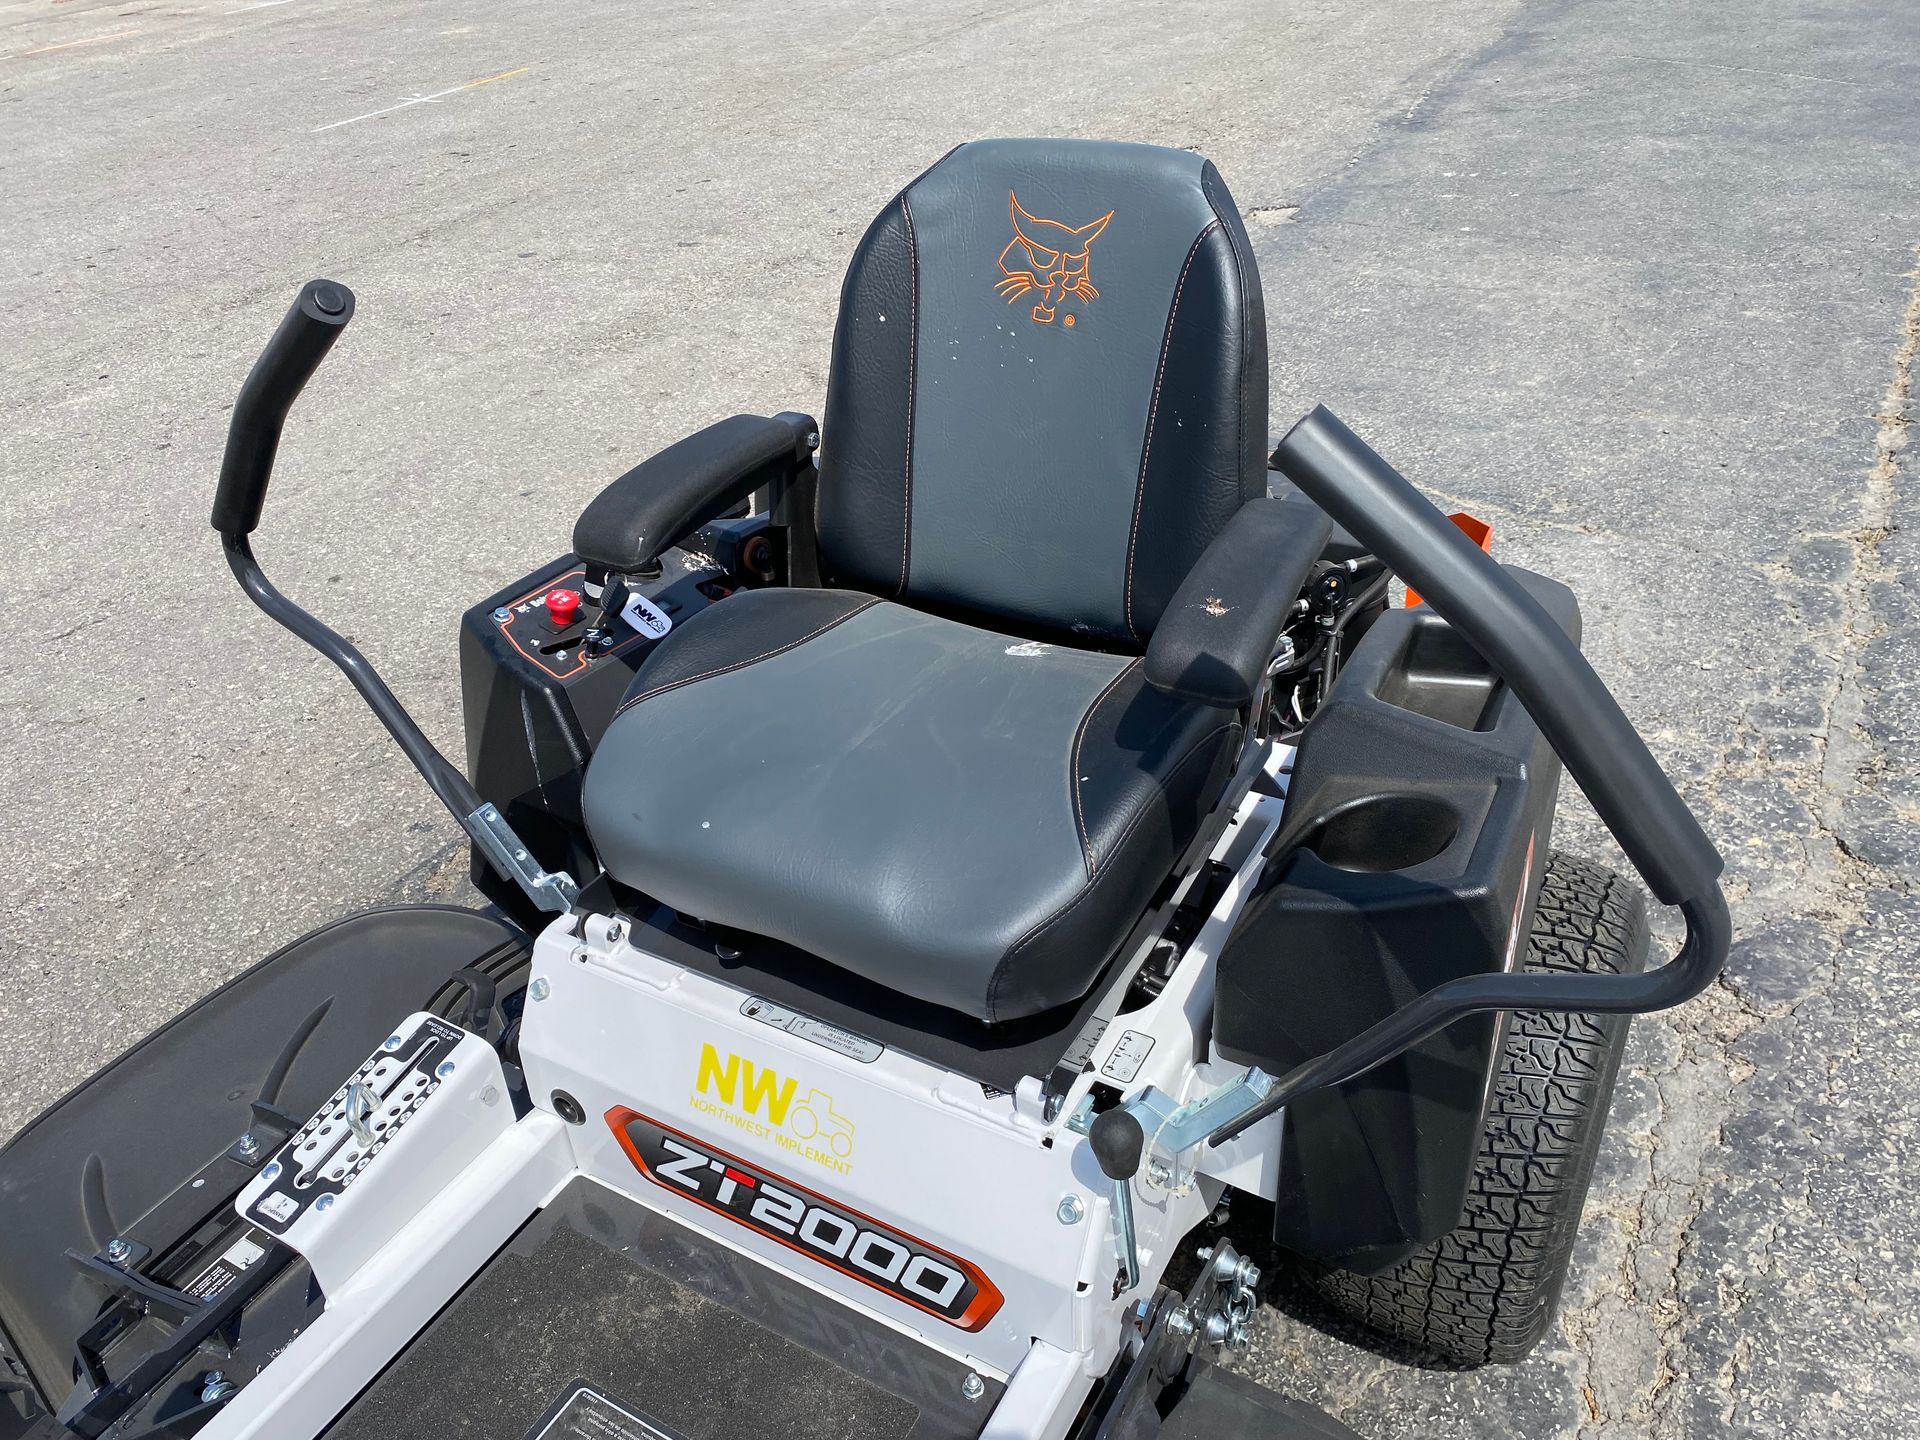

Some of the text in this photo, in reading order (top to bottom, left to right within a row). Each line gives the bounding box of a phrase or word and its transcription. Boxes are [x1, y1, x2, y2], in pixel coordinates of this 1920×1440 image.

[633, 604, 657, 622] NW
[833, 1034, 856, 1046] LOCATED
[852, 1047, 865, 1055] SEAT
[696, 1042, 798, 1126] NW
[689, 1096, 854, 1176] NORTHWEST IMPLEMENT
[655, 1137, 967, 1309] ZT2000
